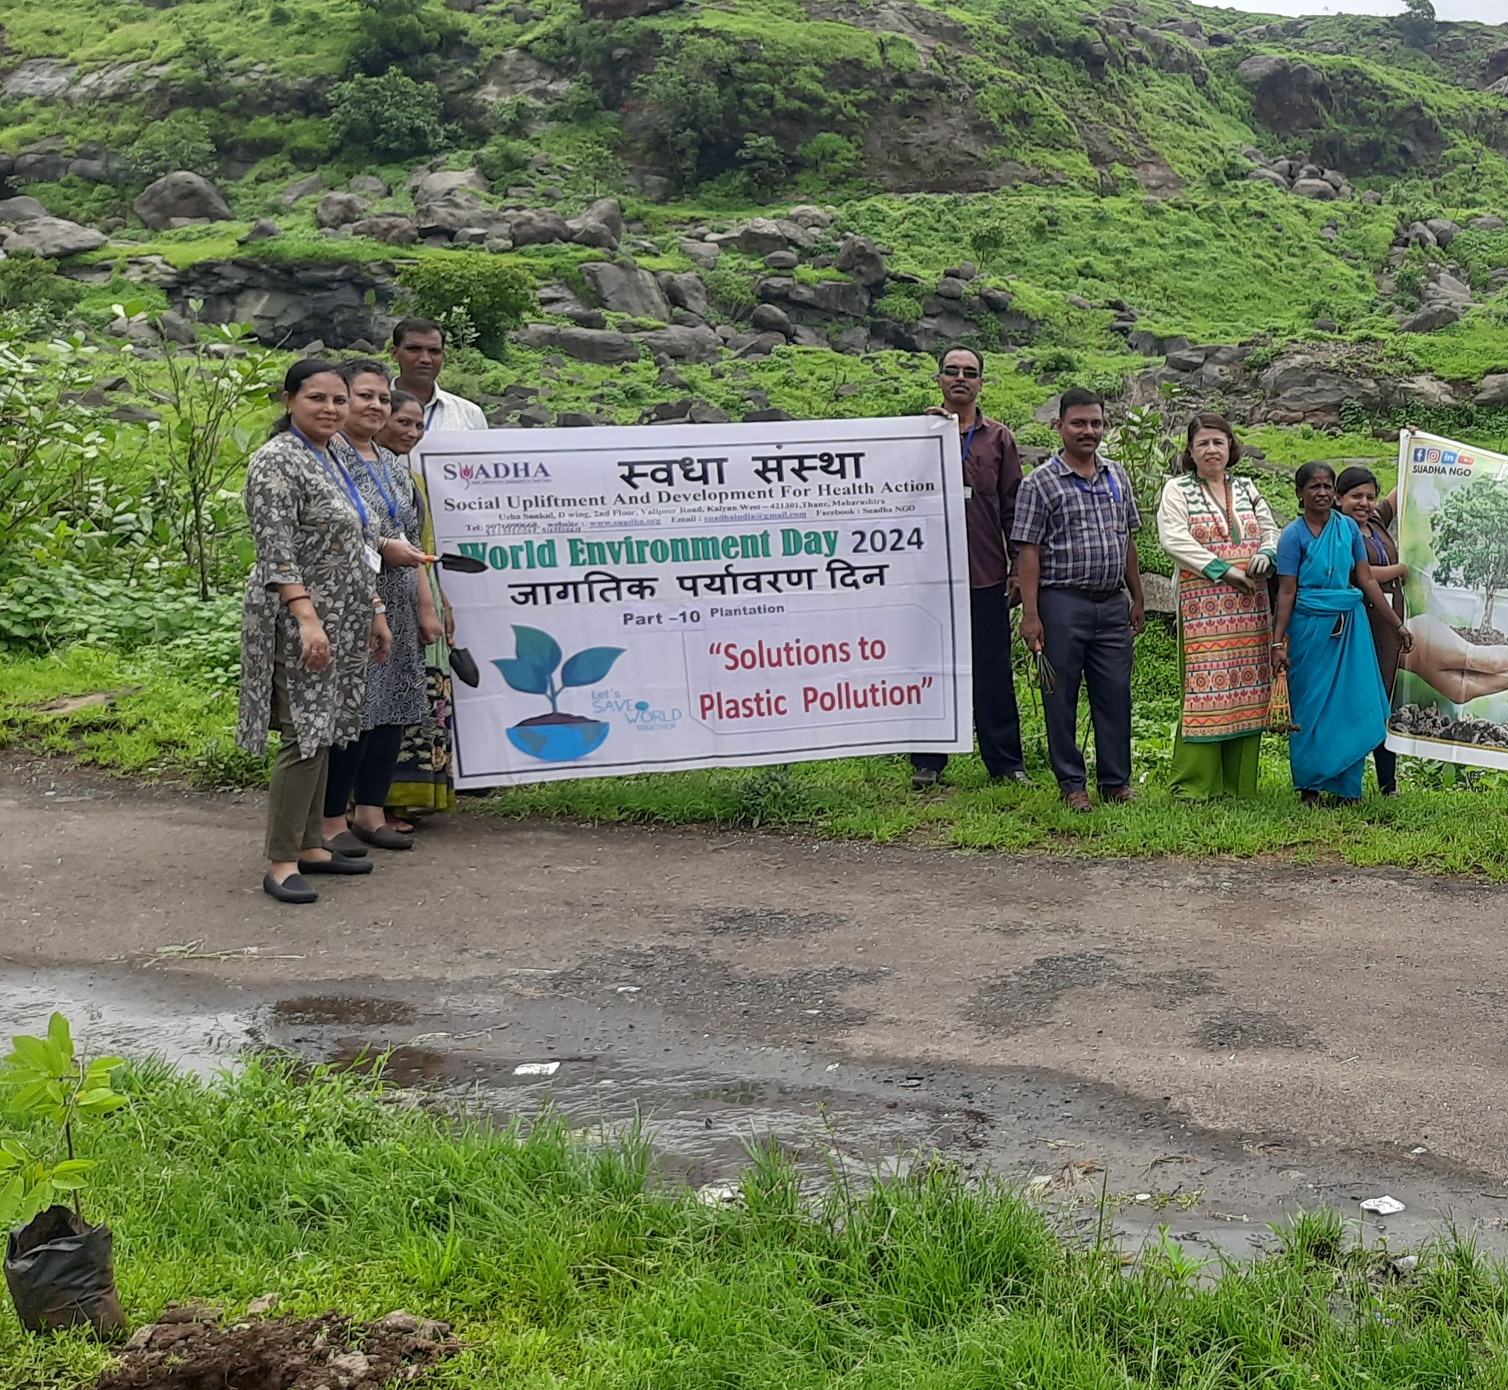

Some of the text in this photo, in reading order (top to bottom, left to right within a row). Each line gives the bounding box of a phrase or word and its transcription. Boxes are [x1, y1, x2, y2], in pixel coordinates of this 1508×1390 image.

[617, 444, 865, 490] स्वधा संस्था
[1412, 465, 1471, 476] SUADHA NGO
[444, 480, 935, 512] Social Upliftment And Development For Health Action
[594, 509, 610, 517] 2nd
[707, 505, 737, 513] Kalyan
[458, 527, 924, 570] World Environment Day 2024
[508, 559, 890, 605] जागतिक पर्यावरण दिन
[623, 612, 663, 625] Part
[710, 605, 785, 618] Plantation
[709, 636, 886, 671] “Solutions to
[592, 698, 633, 713] SAVE
[699, 676, 933, 720] Plastic Pollution”
[624, 708, 682, 723] WORLD
